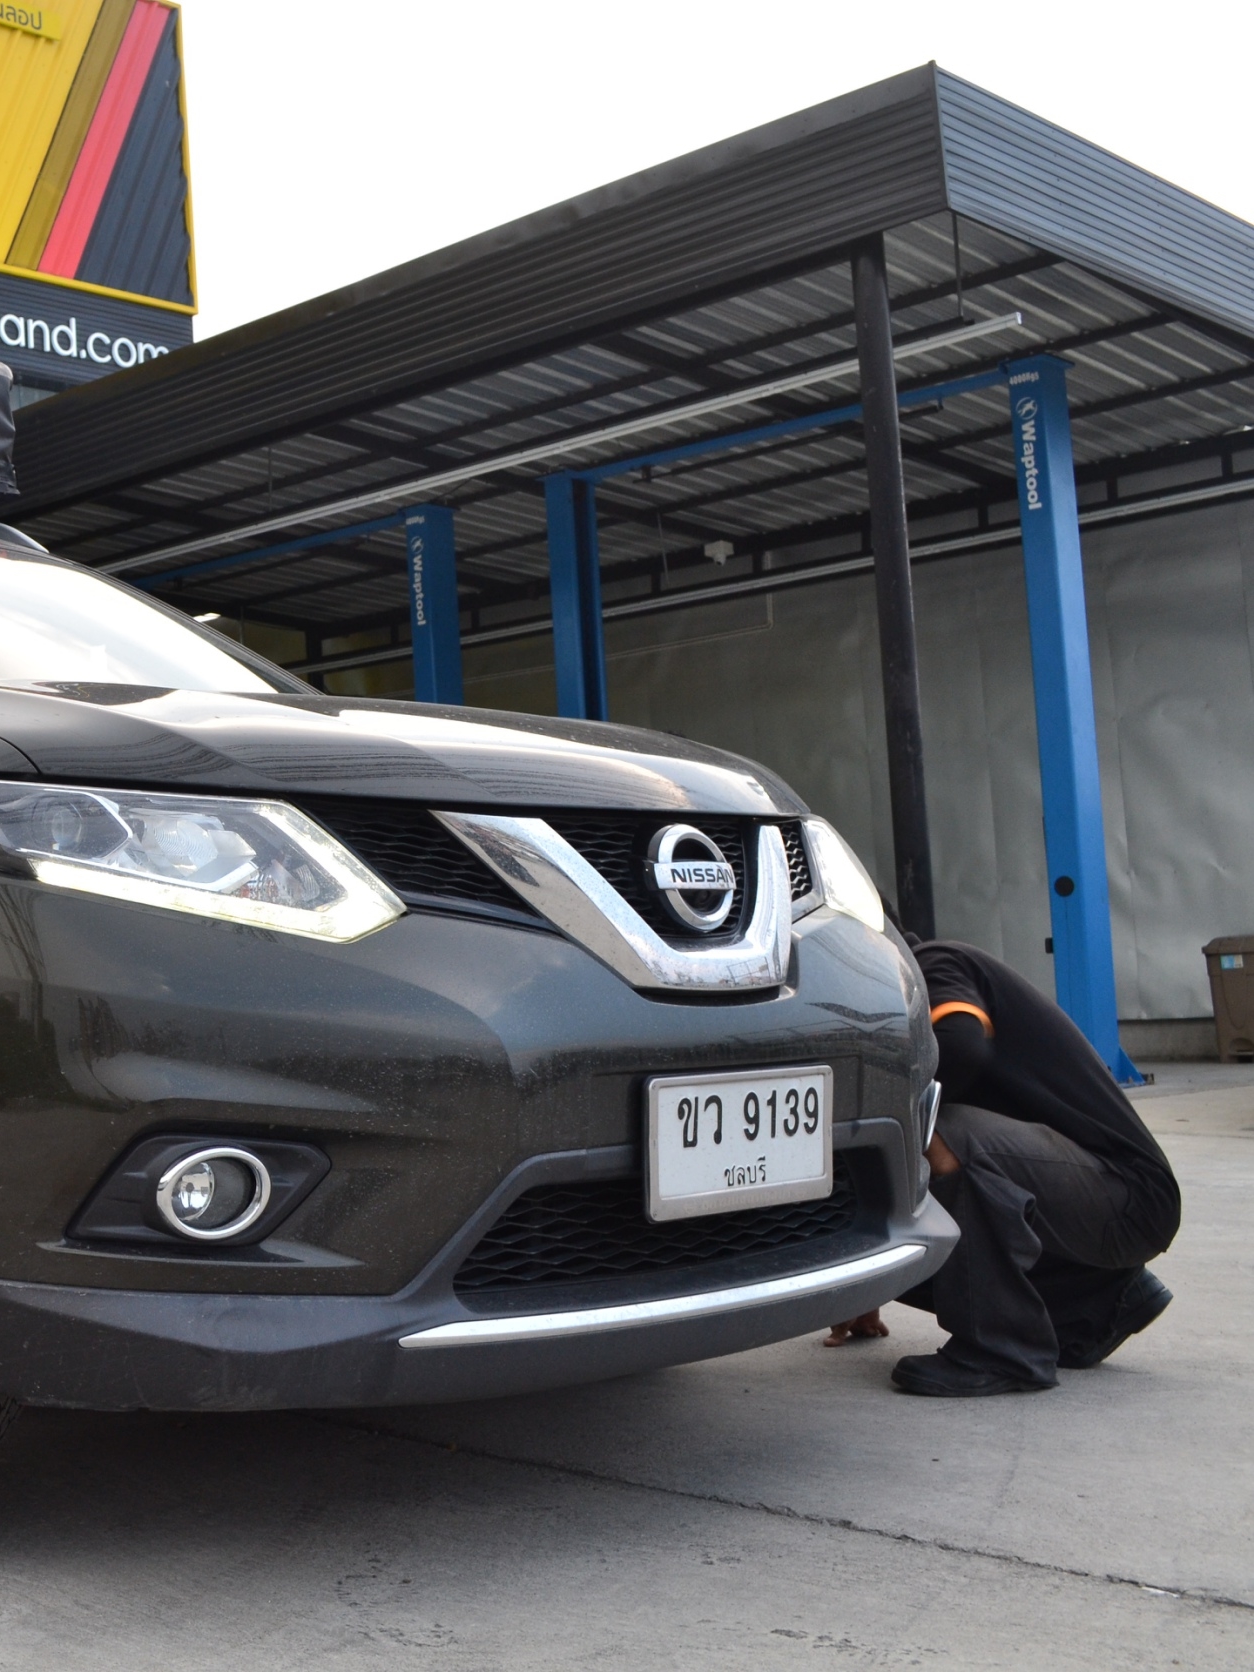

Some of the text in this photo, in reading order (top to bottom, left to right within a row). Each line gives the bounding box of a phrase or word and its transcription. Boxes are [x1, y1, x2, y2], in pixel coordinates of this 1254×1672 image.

[1021, 420, 1043, 510] Waptool
[413, 554, 426, 625] Waptool
[670, 867, 734, 883] NISSAN
[677, 1087, 819, 1148] ขว 9139
